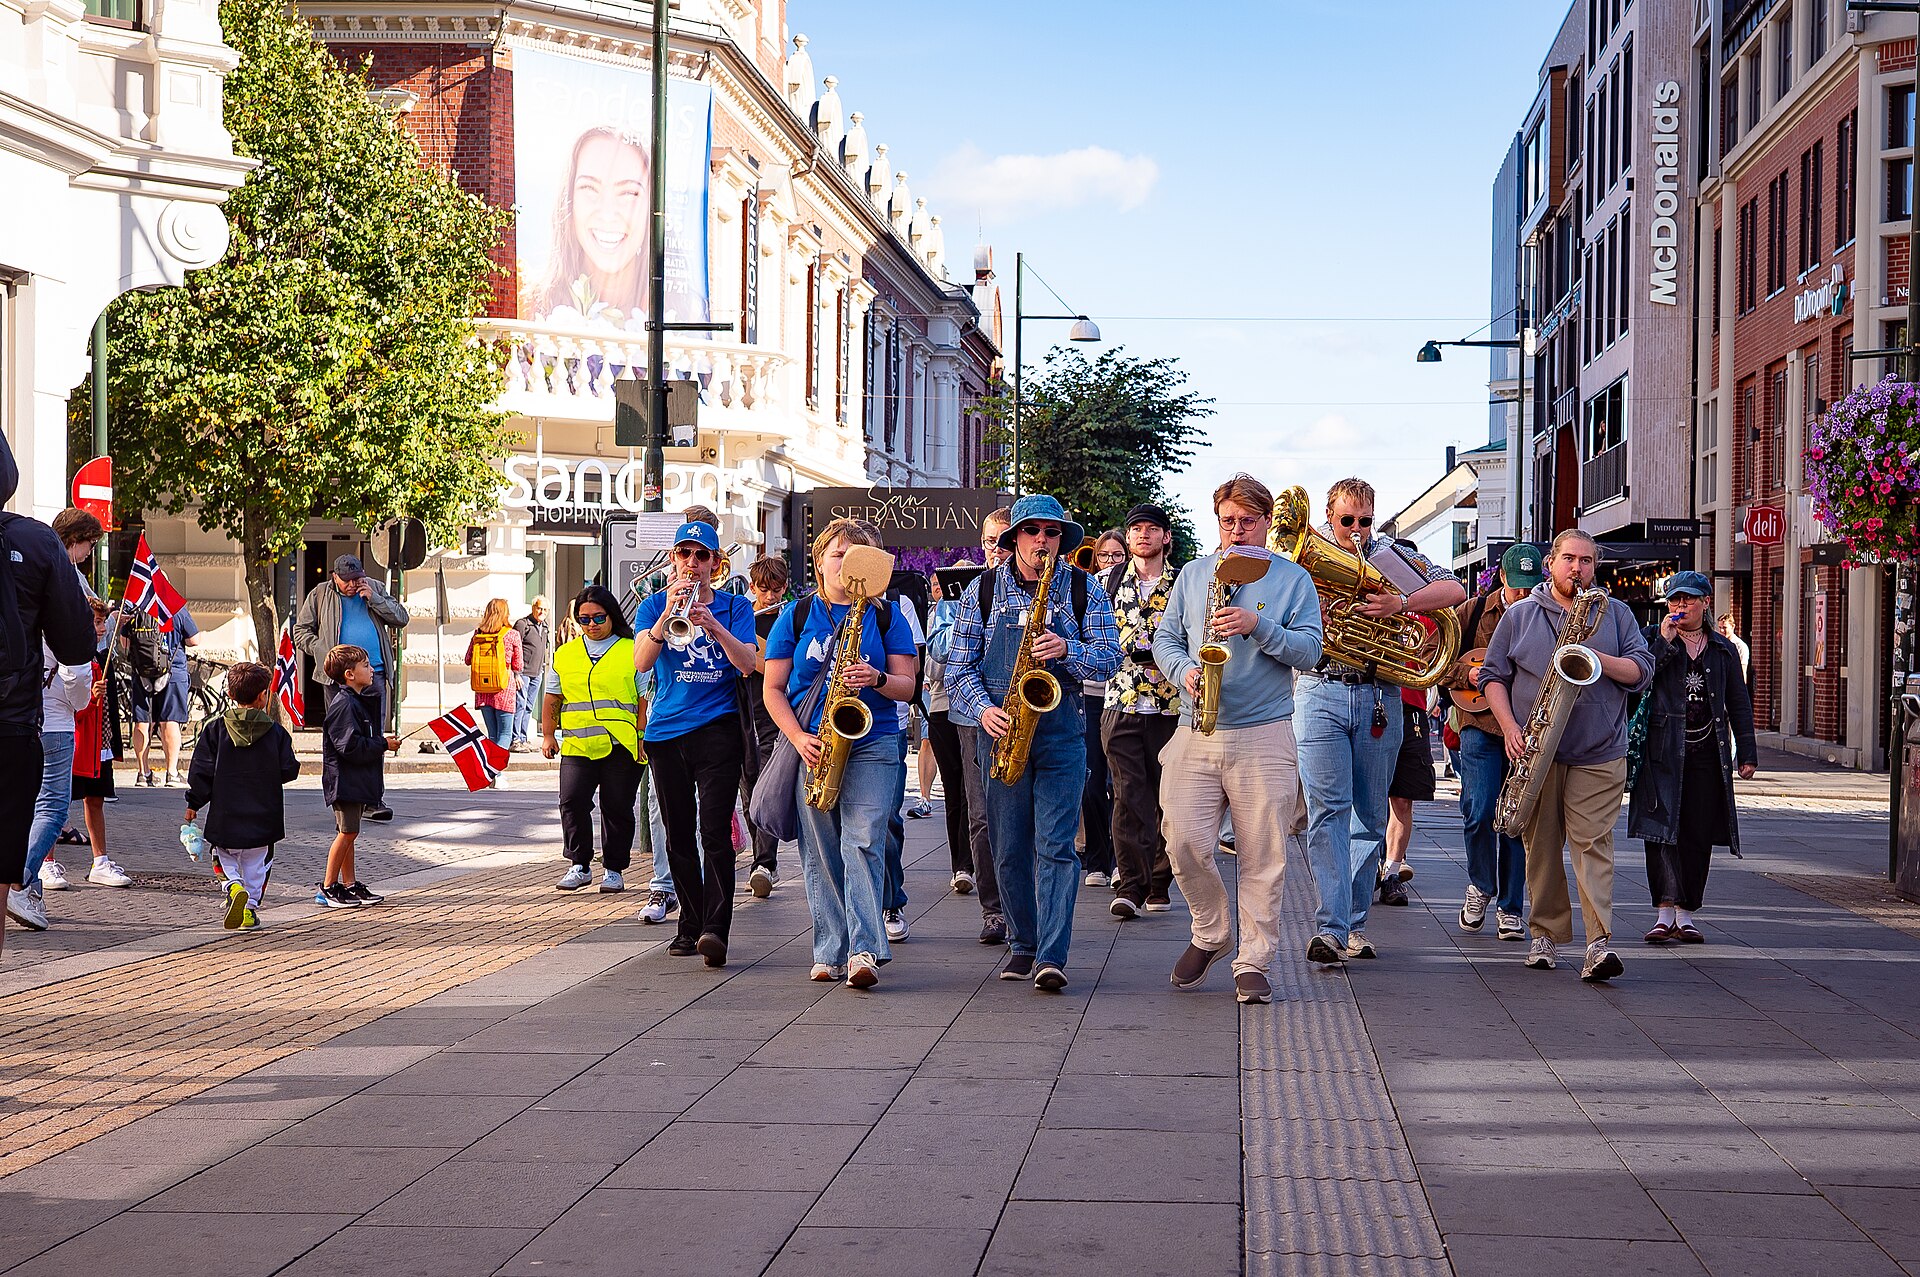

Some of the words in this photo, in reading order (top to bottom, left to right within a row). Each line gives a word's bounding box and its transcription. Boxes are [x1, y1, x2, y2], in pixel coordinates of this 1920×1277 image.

[1650, 80, 1680, 305] McDonald's
[830, 502, 979, 530] SEBASTIÁN
[867, 475, 928, 523] San
[1753, 513, 1777, 537] deli
